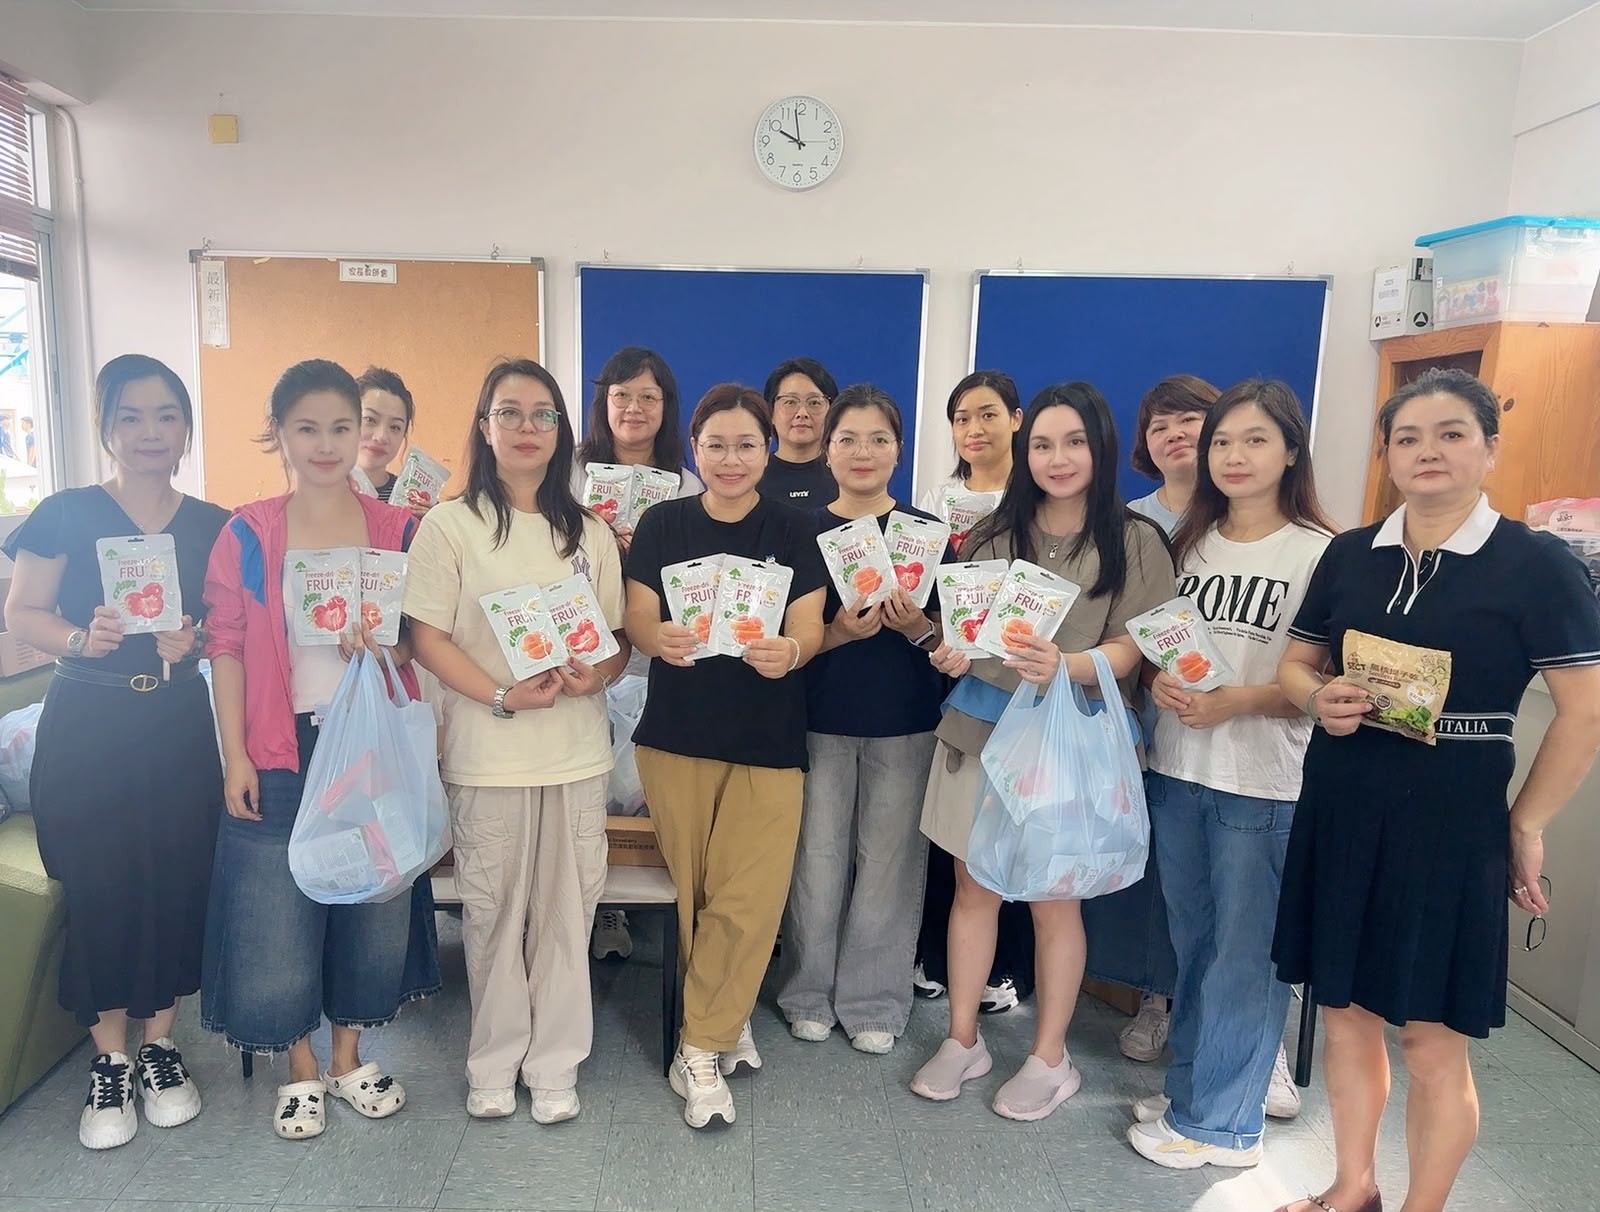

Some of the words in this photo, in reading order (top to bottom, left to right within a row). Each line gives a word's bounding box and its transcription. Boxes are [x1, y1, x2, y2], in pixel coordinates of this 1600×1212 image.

[781, 107, 790, 120] 11
[768, 119, 782, 132] 10
[823, 120, 833, 133] 2
[761, 135, 771, 148] 9
[828, 137, 837, 151] 3
[766, 152, 775, 166] 8
[821, 155, 829, 167] 4
[779, 165, 786, 178] 7
[793, 170, 802, 183] 6
[809, 166, 818, 180] 5
[413, 469, 432, 488] FRUI
[592, 484, 612, 495] FRUI
[641, 488, 661, 500] FRUI
[841, 548, 867, 565] FRUI
[119, 566, 146, 578] FRU
[305, 571, 334, 579] Freeze-dri
[306, 579, 335, 591] FRUI
[360, 578, 379, 591] RUI
[956, 592, 989, 606] FUI
[1014, 592, 1043, 614] FRUI
[1177, 574, 1290, 632] ROME
[551, 608, 578, 625] FRUI
[1152, 624, 1180, 641] Freeze-dri
[1157, 628, 1191, 651] FRUIT
[1438, 719, 1489, 733] ITALIA
